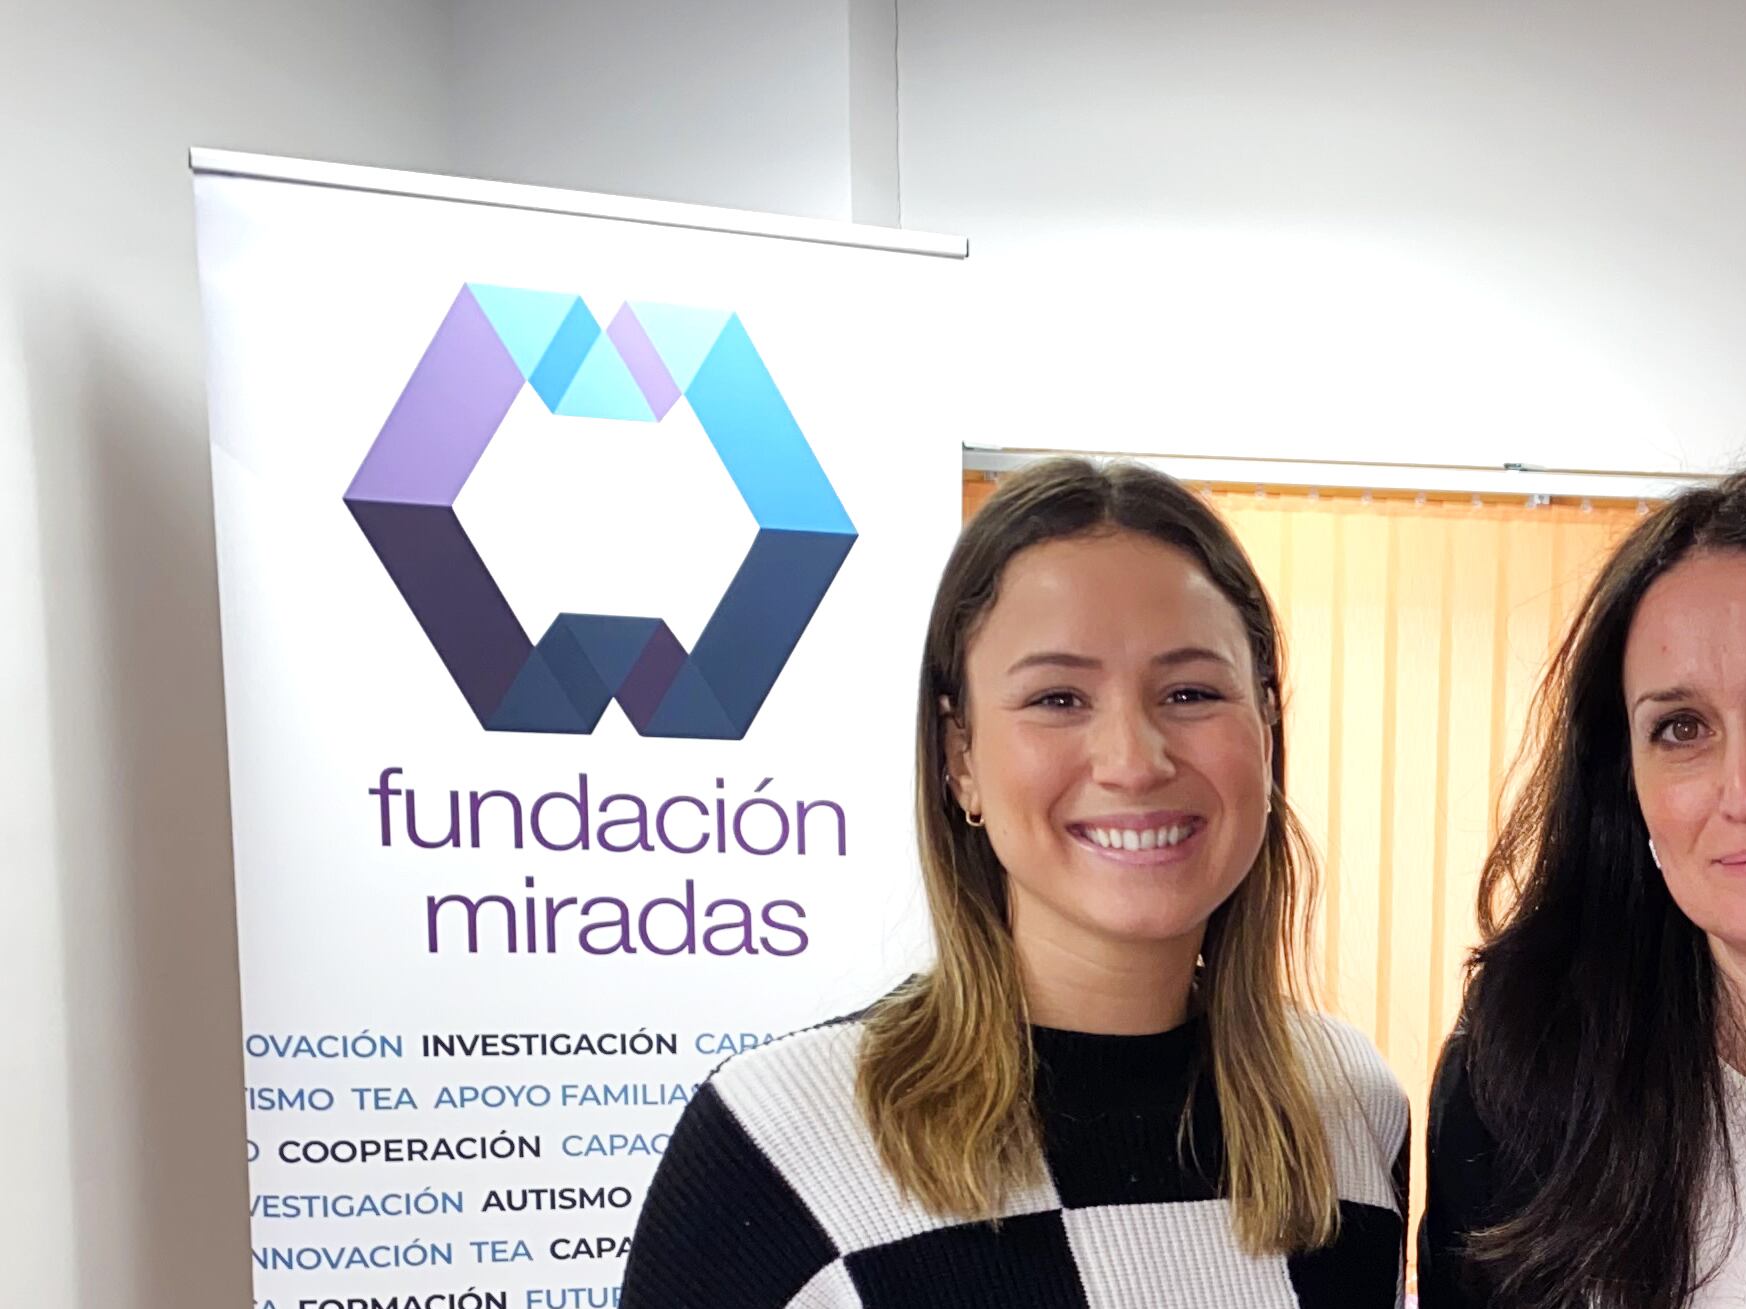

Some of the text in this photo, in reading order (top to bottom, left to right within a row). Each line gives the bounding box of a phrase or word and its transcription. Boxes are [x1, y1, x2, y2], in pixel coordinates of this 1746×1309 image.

[368, 767, 846, 856] fundación
[427, 876, 808, 957] miradas
[246, 1030, 402, 1059] OVACIÓN
[422, 1027, 677, 1057] INVESTIGACIÓN
[244, 1087, 334, 1111] ISMO
[351, 1087, 418, 1111] TEA
[434, 1085, 550, 1109] APOYO
[278, 1130, 540, 1164] COOPERACIÓN
[481, 1187, 632, 1212] AUTISMO
[470, 1240, 533, 1263] TEA
